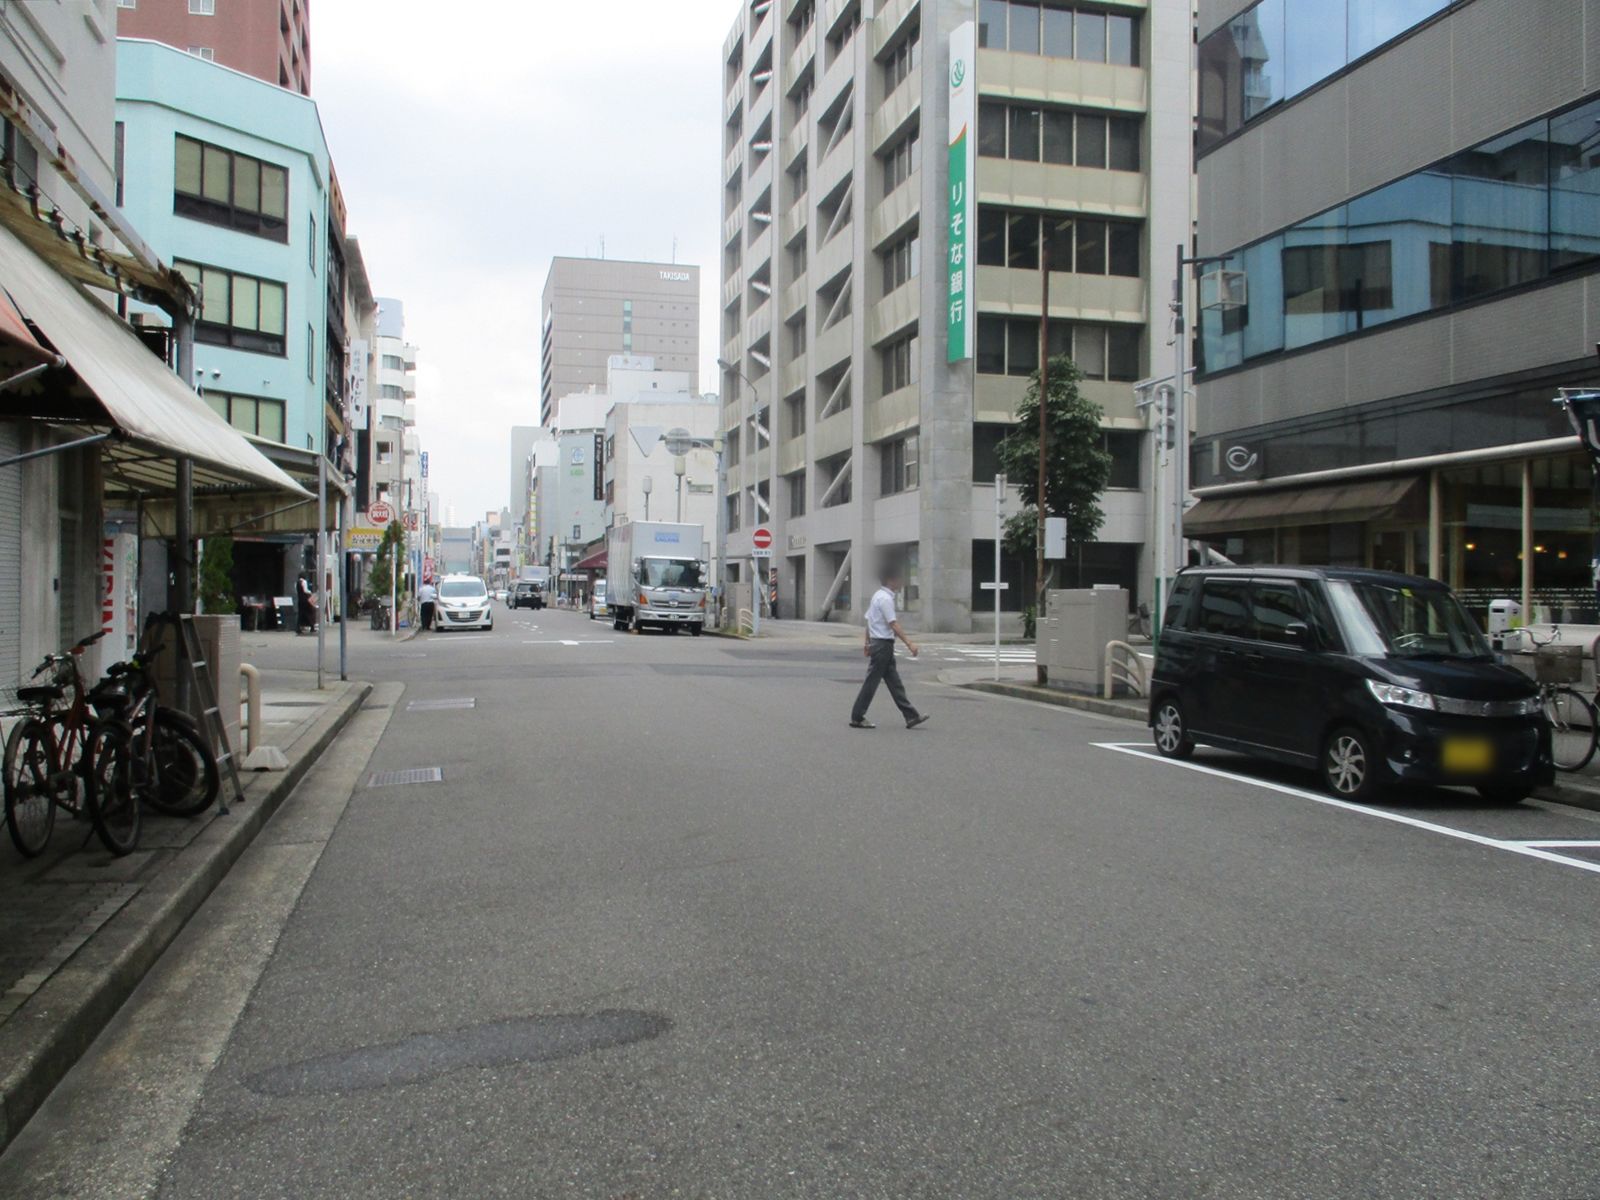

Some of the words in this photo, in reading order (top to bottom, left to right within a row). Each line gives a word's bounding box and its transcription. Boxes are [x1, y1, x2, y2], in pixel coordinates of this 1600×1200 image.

[659, 271, 690, 281] TAKISADA
[950, 181, 964, 325] りそな銀行
